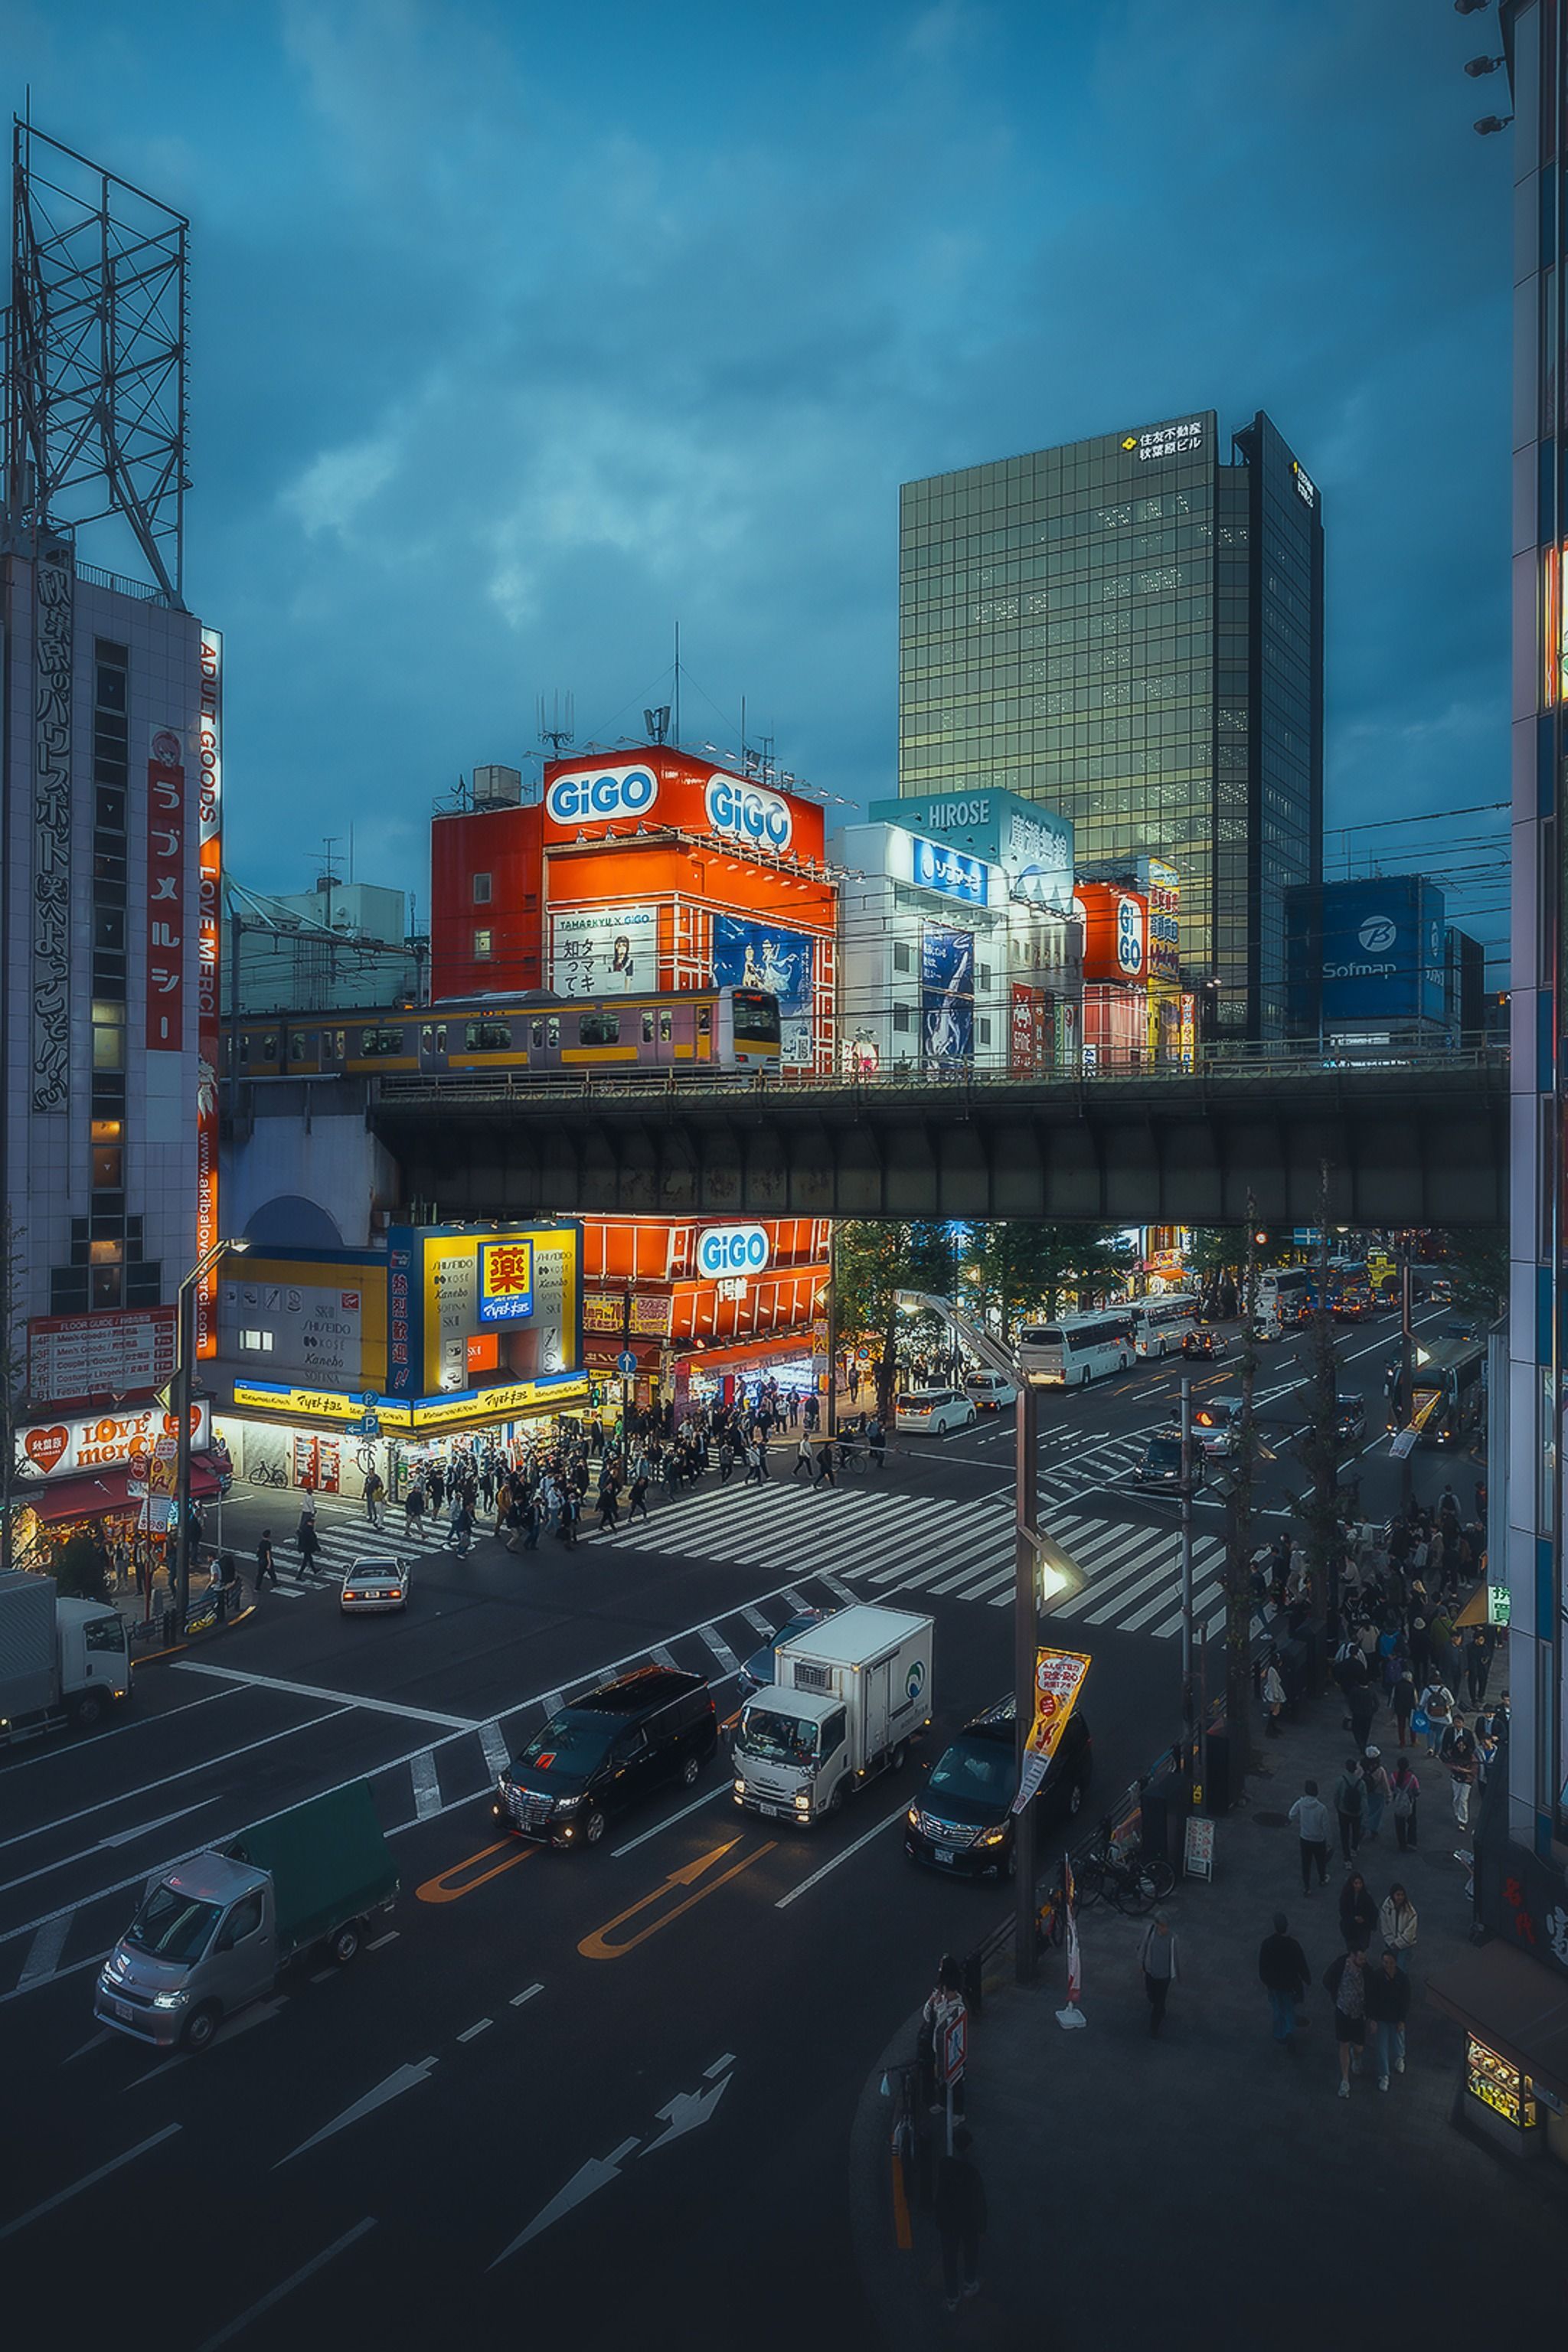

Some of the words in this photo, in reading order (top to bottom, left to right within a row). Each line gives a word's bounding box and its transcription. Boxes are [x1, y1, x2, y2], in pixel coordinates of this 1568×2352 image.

[199, 641, 217, 725] ADULT
[199, 730, 217, 824] GOODS
[552, 772, 652, 817] GiGO
[710, 782, 788, 844] GiGO
[929, 800, 991, 828] HIROSE
[151, 779, 180, 1039] ラブメルシー
[199, 866, 216, 932] LOVE
[199, 936, 215, 1018] MERCI
[1322, 962, 1396, 980] Sofmap
[433, 1259, 474, 1271] SHISEIDO
[536, 1250, 573, 1263] SHISEIDO
[703, 1233, 765, 1270] GiGO
[489, 1247, 525, 1293] 薬
[434, 1287, 469, 1300] Kanebo
[60, 1321, 88, 1331] FLOOR
[301, 1319, 351, 1335] SHISEIDO
[305, 1353, 344, 1367] Kanebo
[365, 1416, 375, 1432] P
